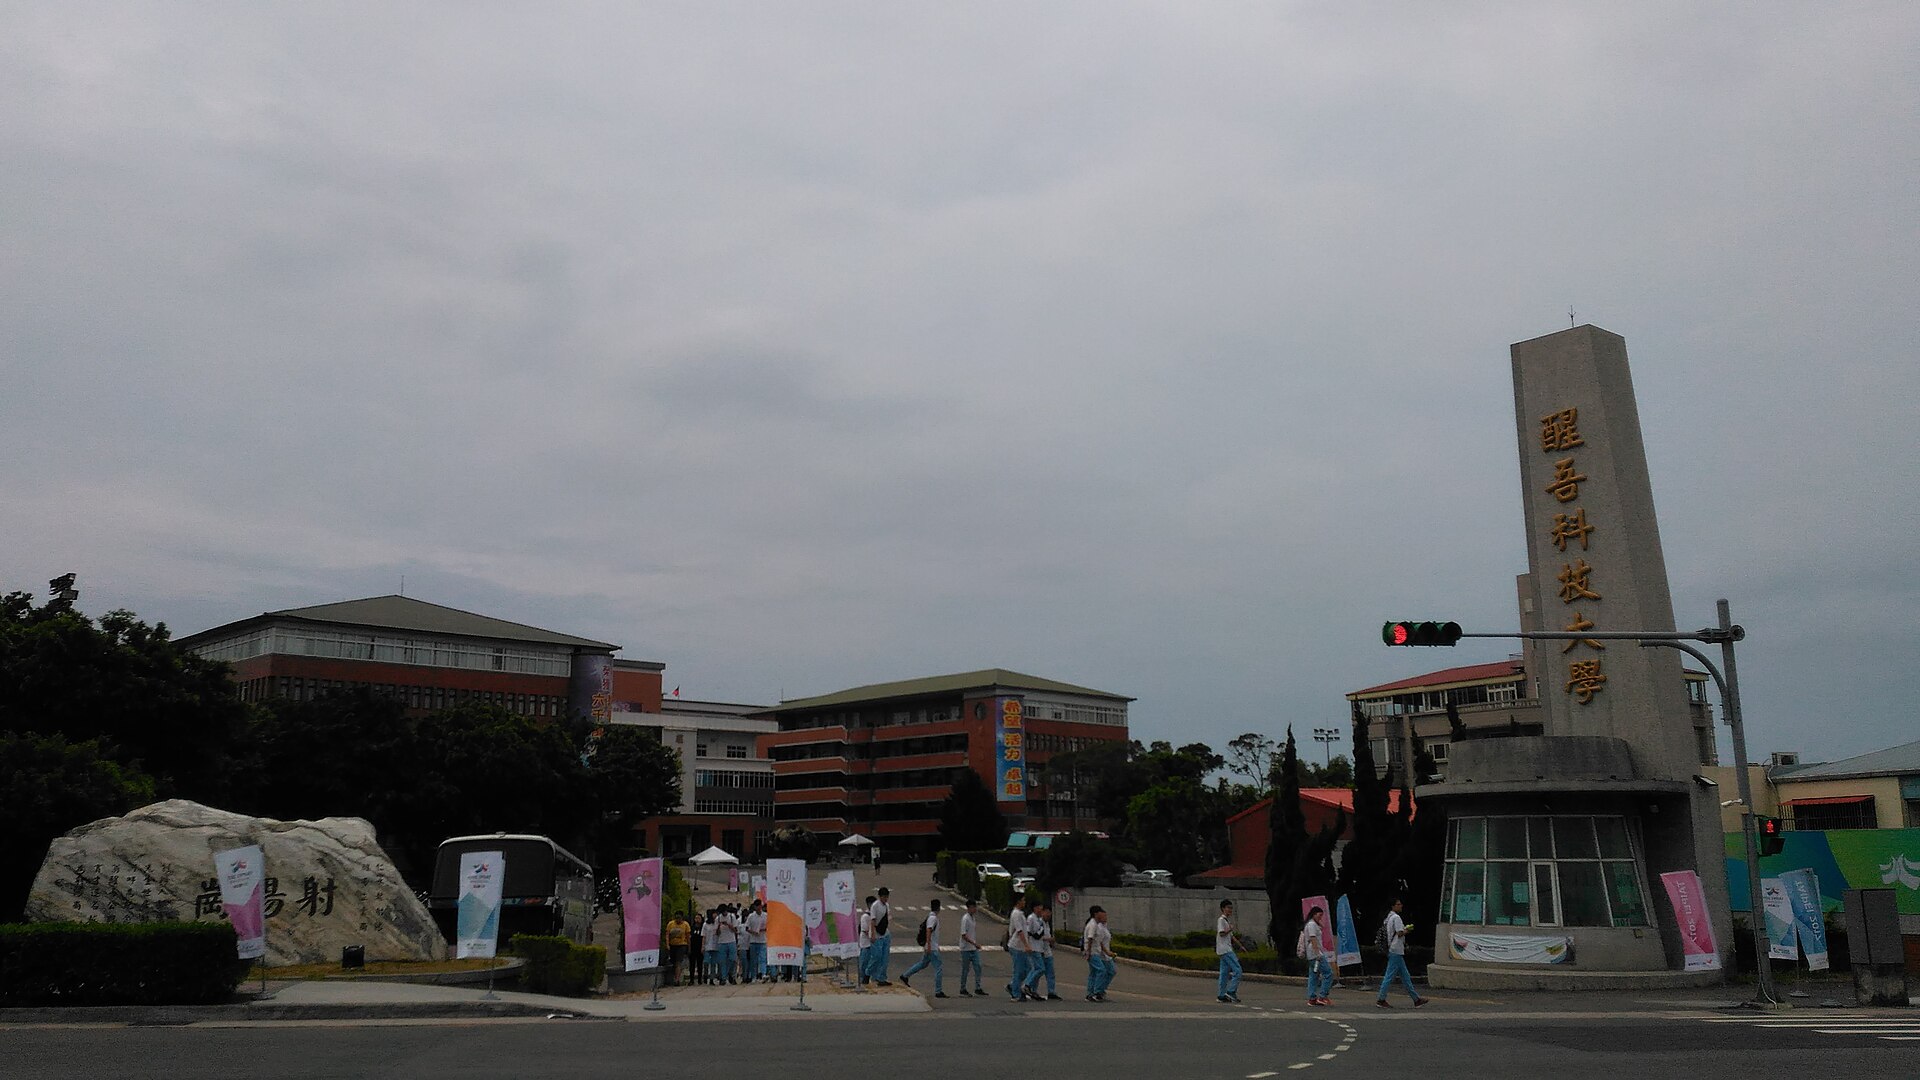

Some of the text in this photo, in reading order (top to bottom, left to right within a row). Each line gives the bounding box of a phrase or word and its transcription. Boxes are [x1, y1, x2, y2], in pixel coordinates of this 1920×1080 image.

[1540, 407, 1607, 705] 醒吾科技大學
[1003, 699, 1023, 796] 希望 活力 卓越
